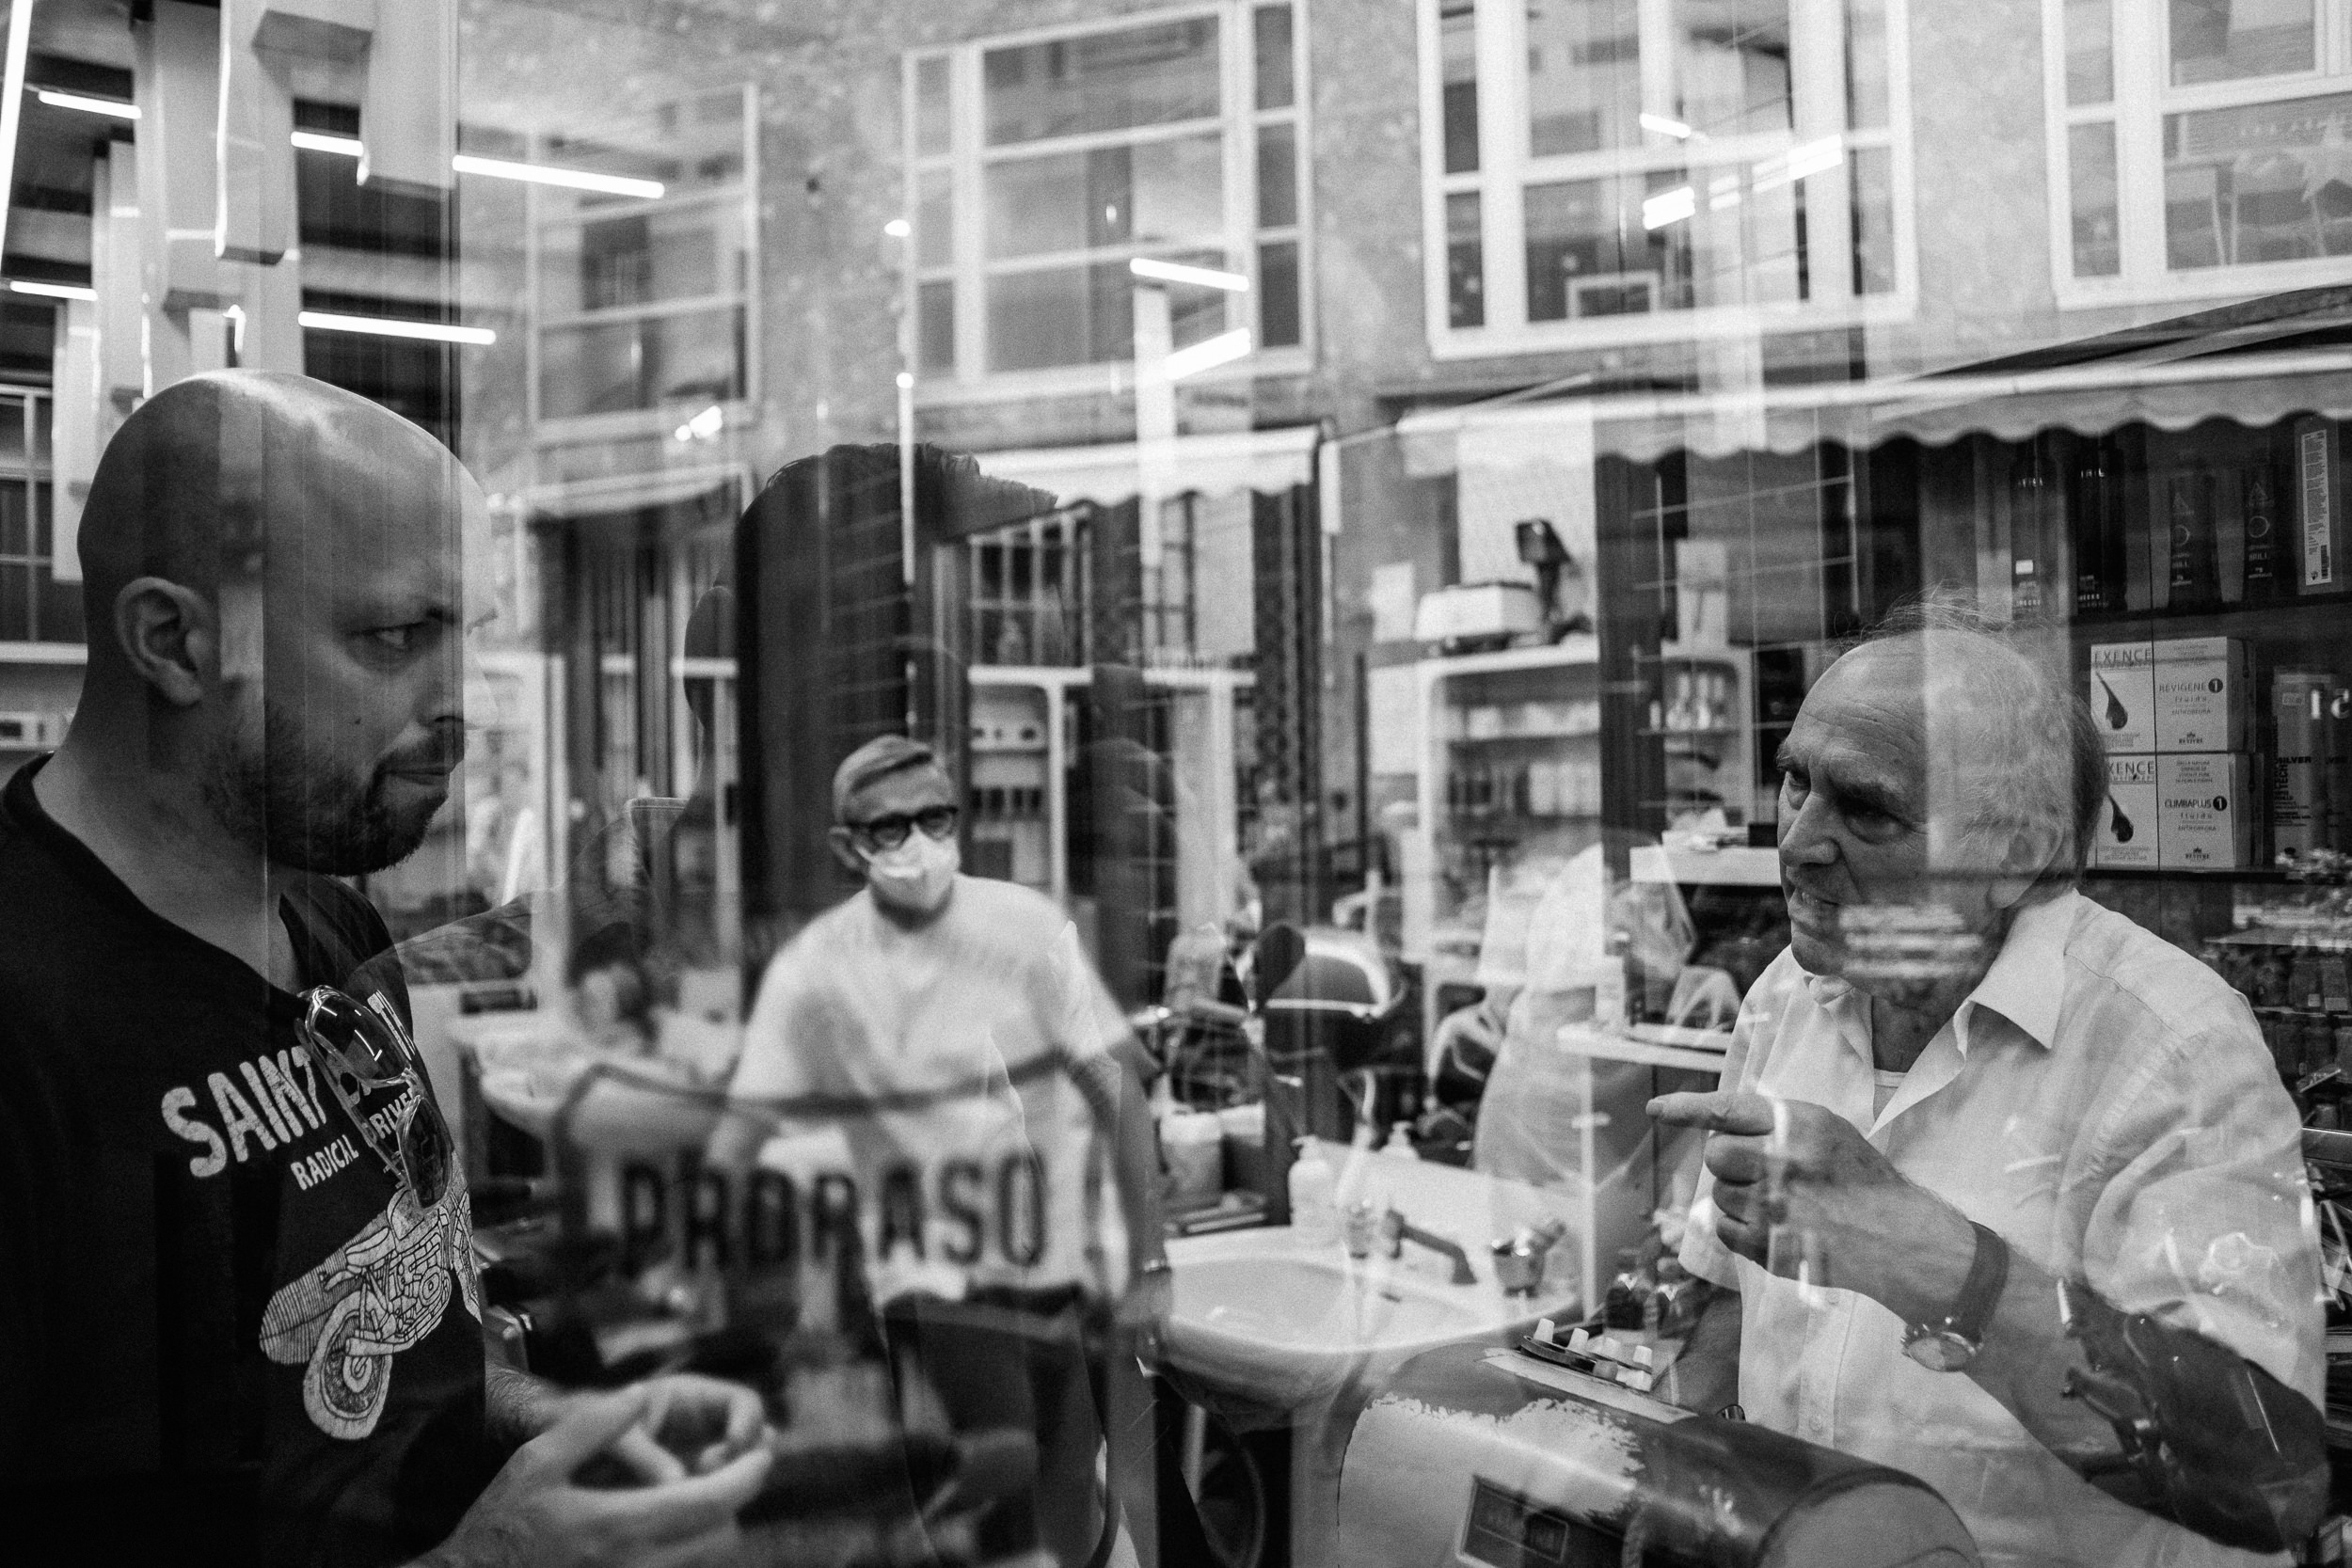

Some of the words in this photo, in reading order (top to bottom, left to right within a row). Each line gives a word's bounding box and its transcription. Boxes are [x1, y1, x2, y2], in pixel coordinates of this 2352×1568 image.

[2094, 648, 2152, 664] EXENCE
[2108, 760, 2155, 774] XENCE
[290, 1133, 359, 1191] RADICAL
[621, 1148, 1045, 1275] PRORASO
